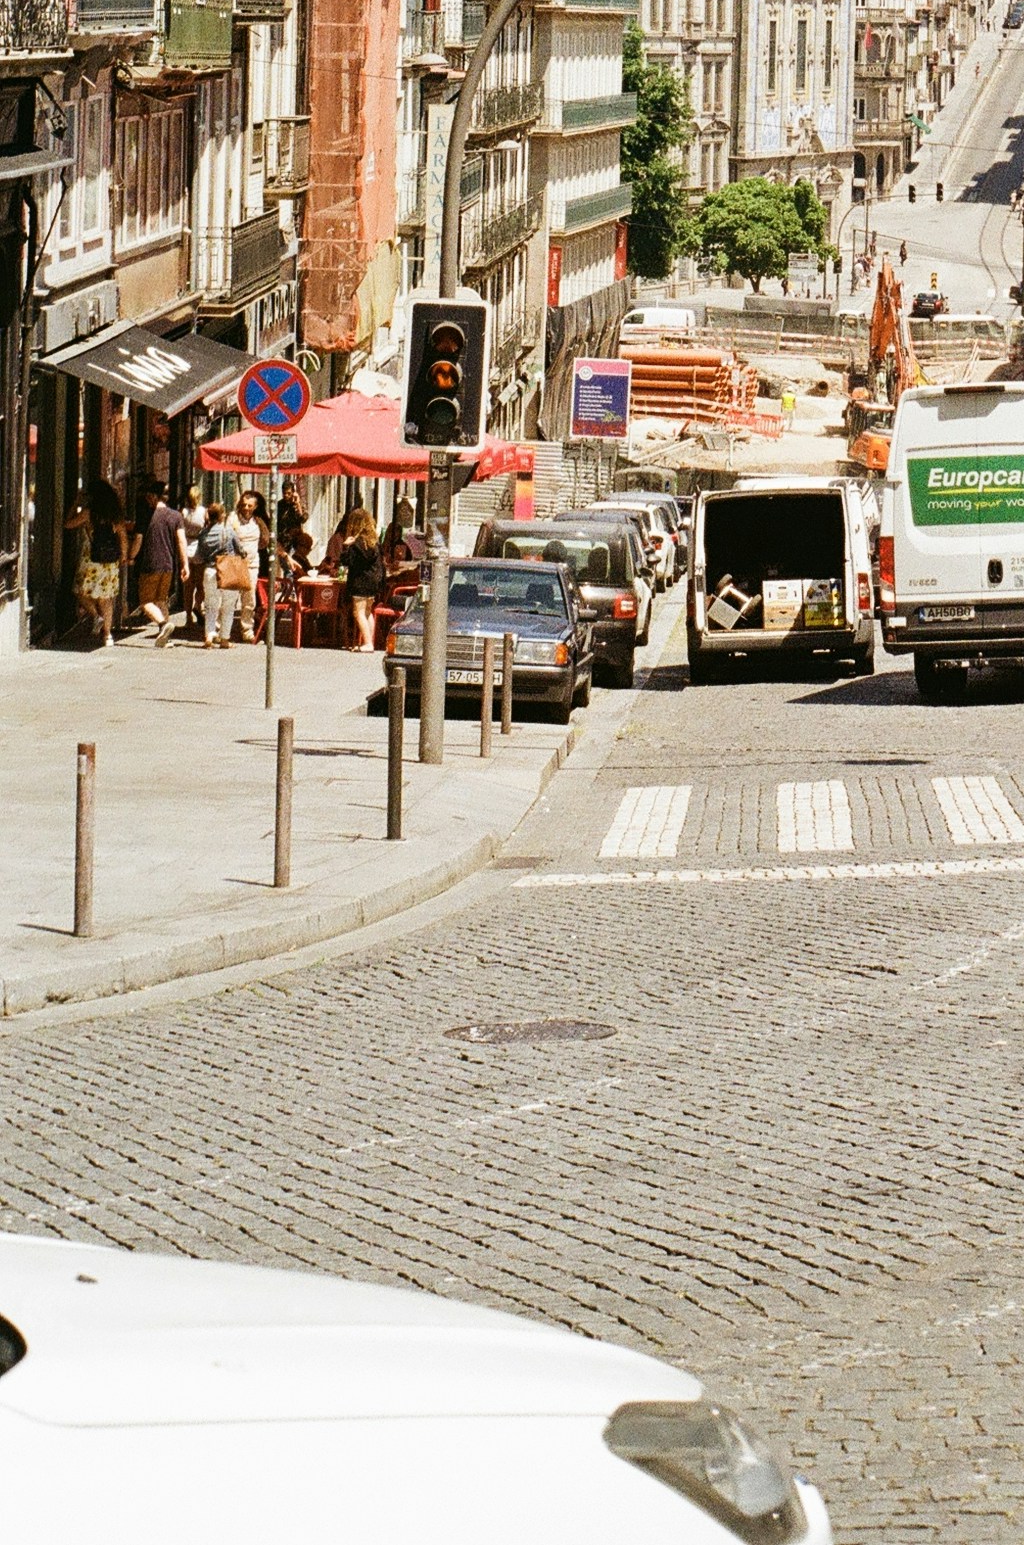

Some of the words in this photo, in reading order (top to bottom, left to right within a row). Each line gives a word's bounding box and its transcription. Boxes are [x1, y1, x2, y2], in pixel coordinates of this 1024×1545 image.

[221, 454, 250, 464] SUPER
[927, 498, 972, 511] moving
[973, 500, 1002, 510] your
